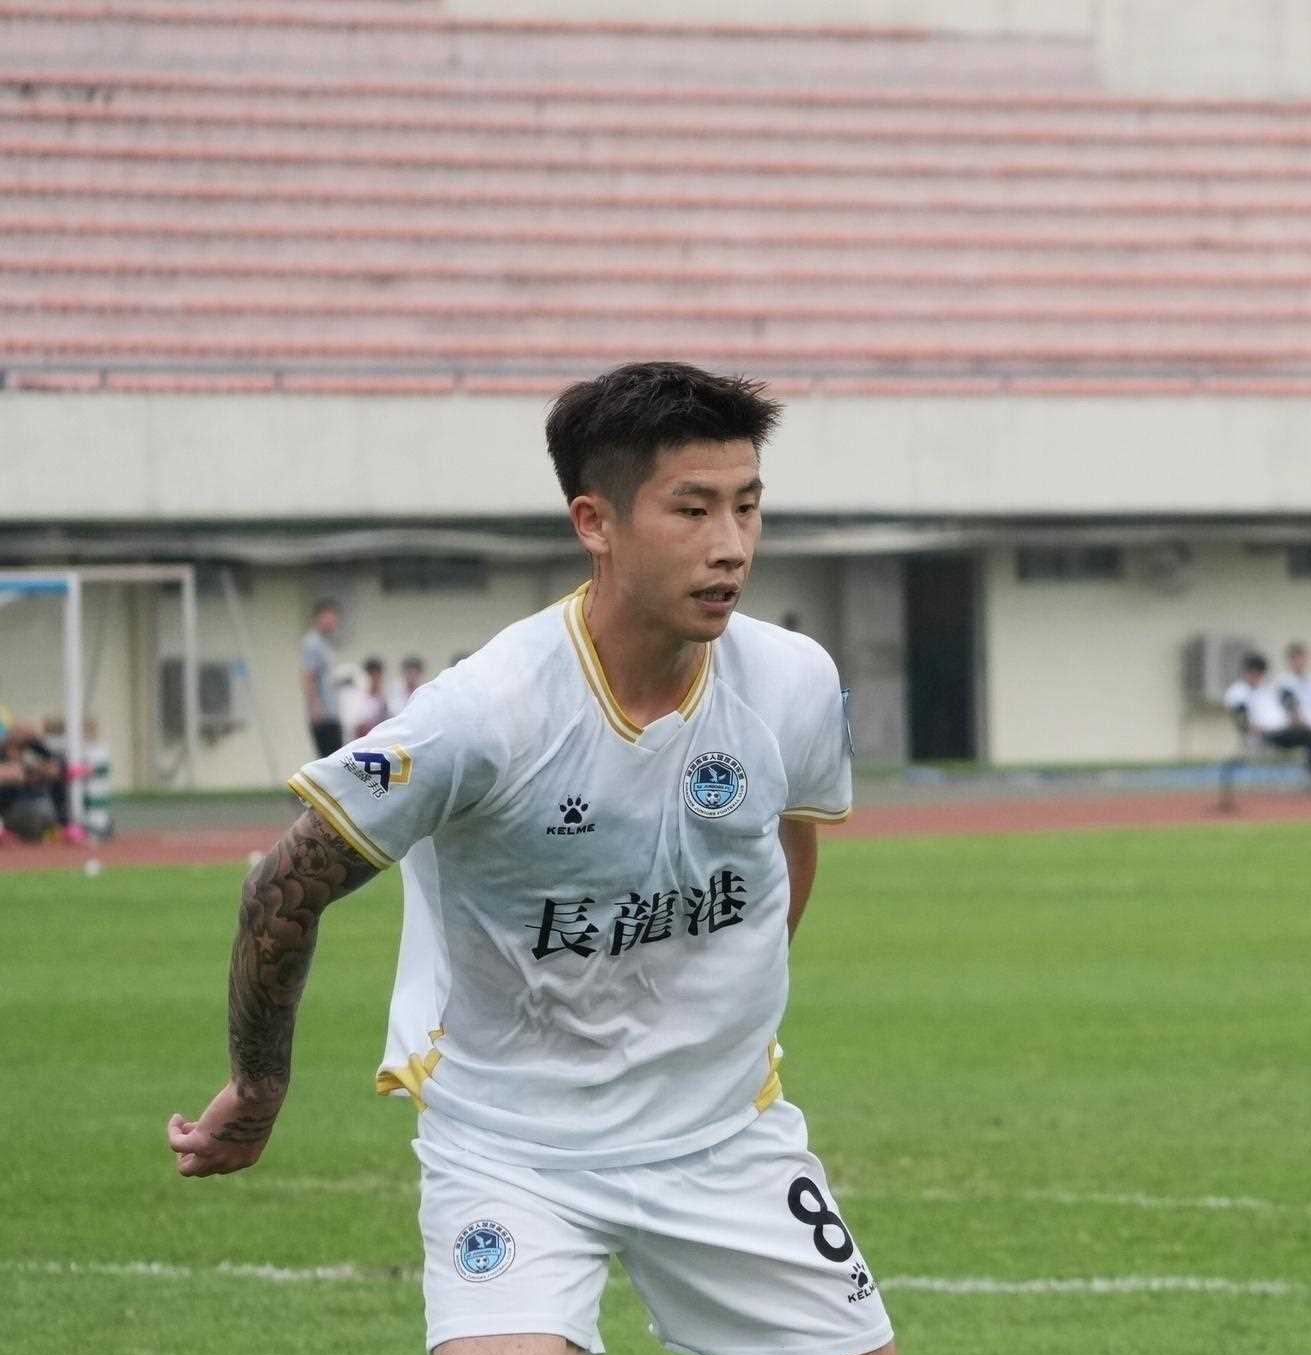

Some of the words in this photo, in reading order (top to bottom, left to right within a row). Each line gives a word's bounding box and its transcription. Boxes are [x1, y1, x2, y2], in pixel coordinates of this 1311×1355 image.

[546, 823, 596, 835] KELME
[524, 871, 748, 960] 長龍港
[787, 1176, 854, 1263] 8
